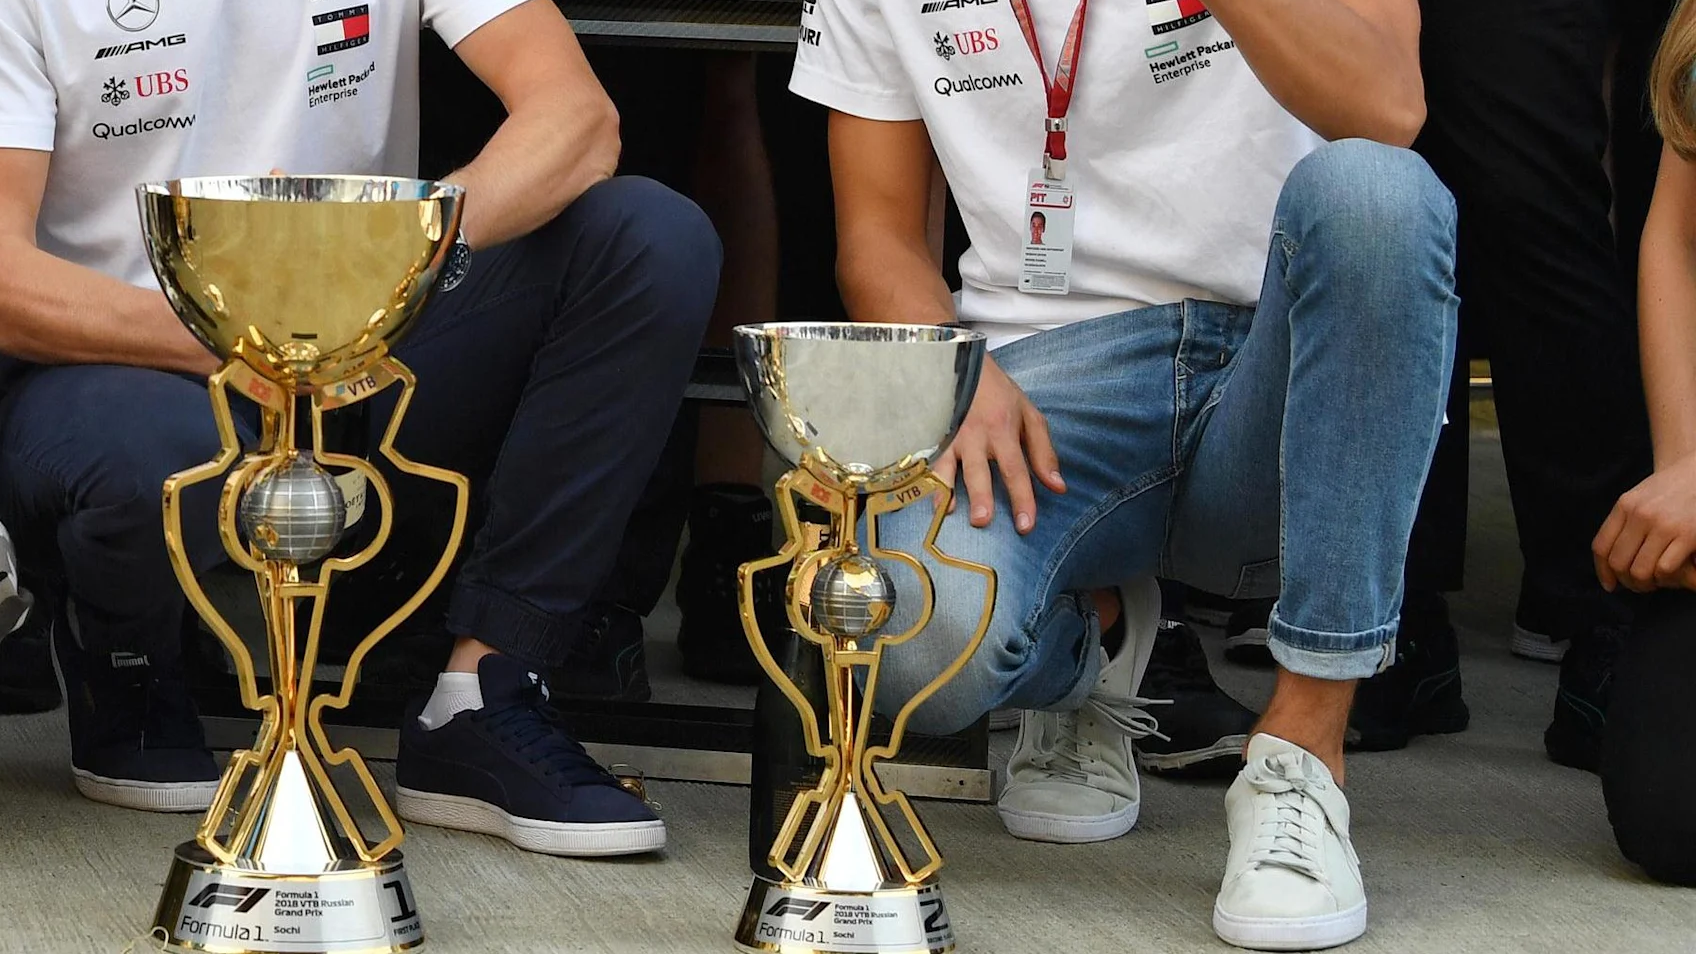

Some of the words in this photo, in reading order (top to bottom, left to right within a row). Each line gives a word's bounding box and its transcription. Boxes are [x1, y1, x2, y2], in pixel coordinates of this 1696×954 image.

[317, 7, 366, 23] TOMMY
[124, 33, 186, 55] AMG
[321, 36, 368, 55] HILFIGER
[800, 25, 822, 47] URI
[954, 28, 999, 56] UBS
[1149, 50, 1197, 73] Hewlett
[1197, 40, 1235, 57] Packar
[308, 77, 347, 98] Hewlett
[348, 61, 376, 86] Pacd
[1153, 59, 1211, 84] Enterprise
[133, 68, 189, 98] UBS
[934, 73, 1023, 97] Qualcomm
[309, 88, 358, 108] Enterprise
[92, 114, 196, 140] Qualcomm
[1029, 192, 1047, 203] PIT
[347, 375, 377, 397] VTB
[895, 485, 921, 504] VTB
[274, 899, 298, 907] 2018
[300, 900, 319, 908] VTB
[320, 899, 355, 907] Russian
[275, 890, 312, 899] Formula
[383, 880, 417, 923] 1
[274, 908, 303, 917] Grand
[919, 898, 949, 933] 2
[180, 915, 250, 941] Formula
[273, 926, 301, 934] Sochi
[759, 922, 815, 943] Formula
[833, 931, 855, 939] Sochi
